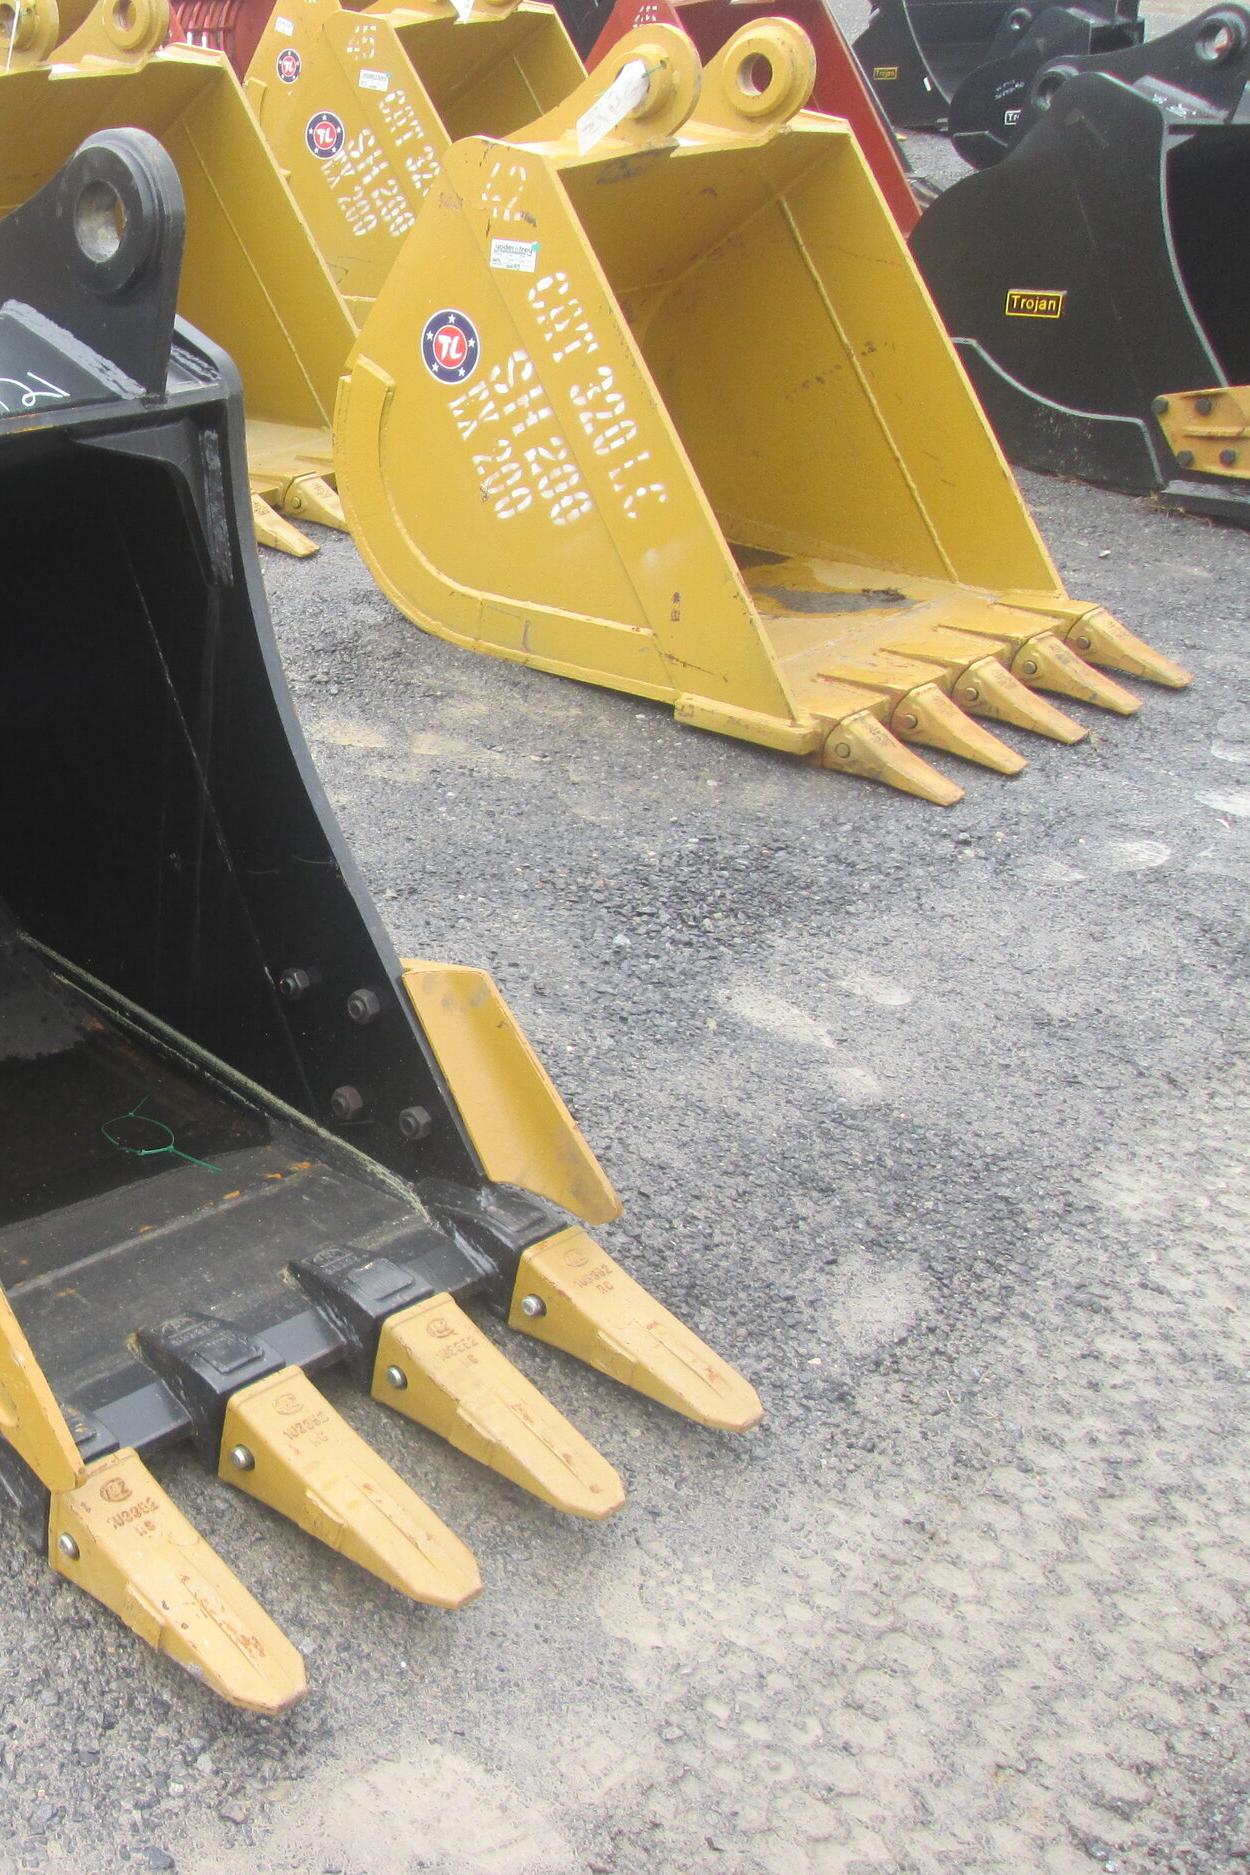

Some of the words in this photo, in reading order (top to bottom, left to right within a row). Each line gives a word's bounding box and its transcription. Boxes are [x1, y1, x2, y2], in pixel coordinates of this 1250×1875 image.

[379, 89, 424, 147] CAT
[337, 184, 377, 237] 200
[348, 128, 390, 185] SH
[371, 178, 415, 237] 200
[1011, 295, 1056, 313] Trojan
[528, 272, 598, 363] CAT
[570, 366, 638, 455] 320
[449, 380, 500, 441] EX
[490, 349, 552, 437] SH
[524, 436, 593, 526] 200
[472, 439, 533, 519] 200
